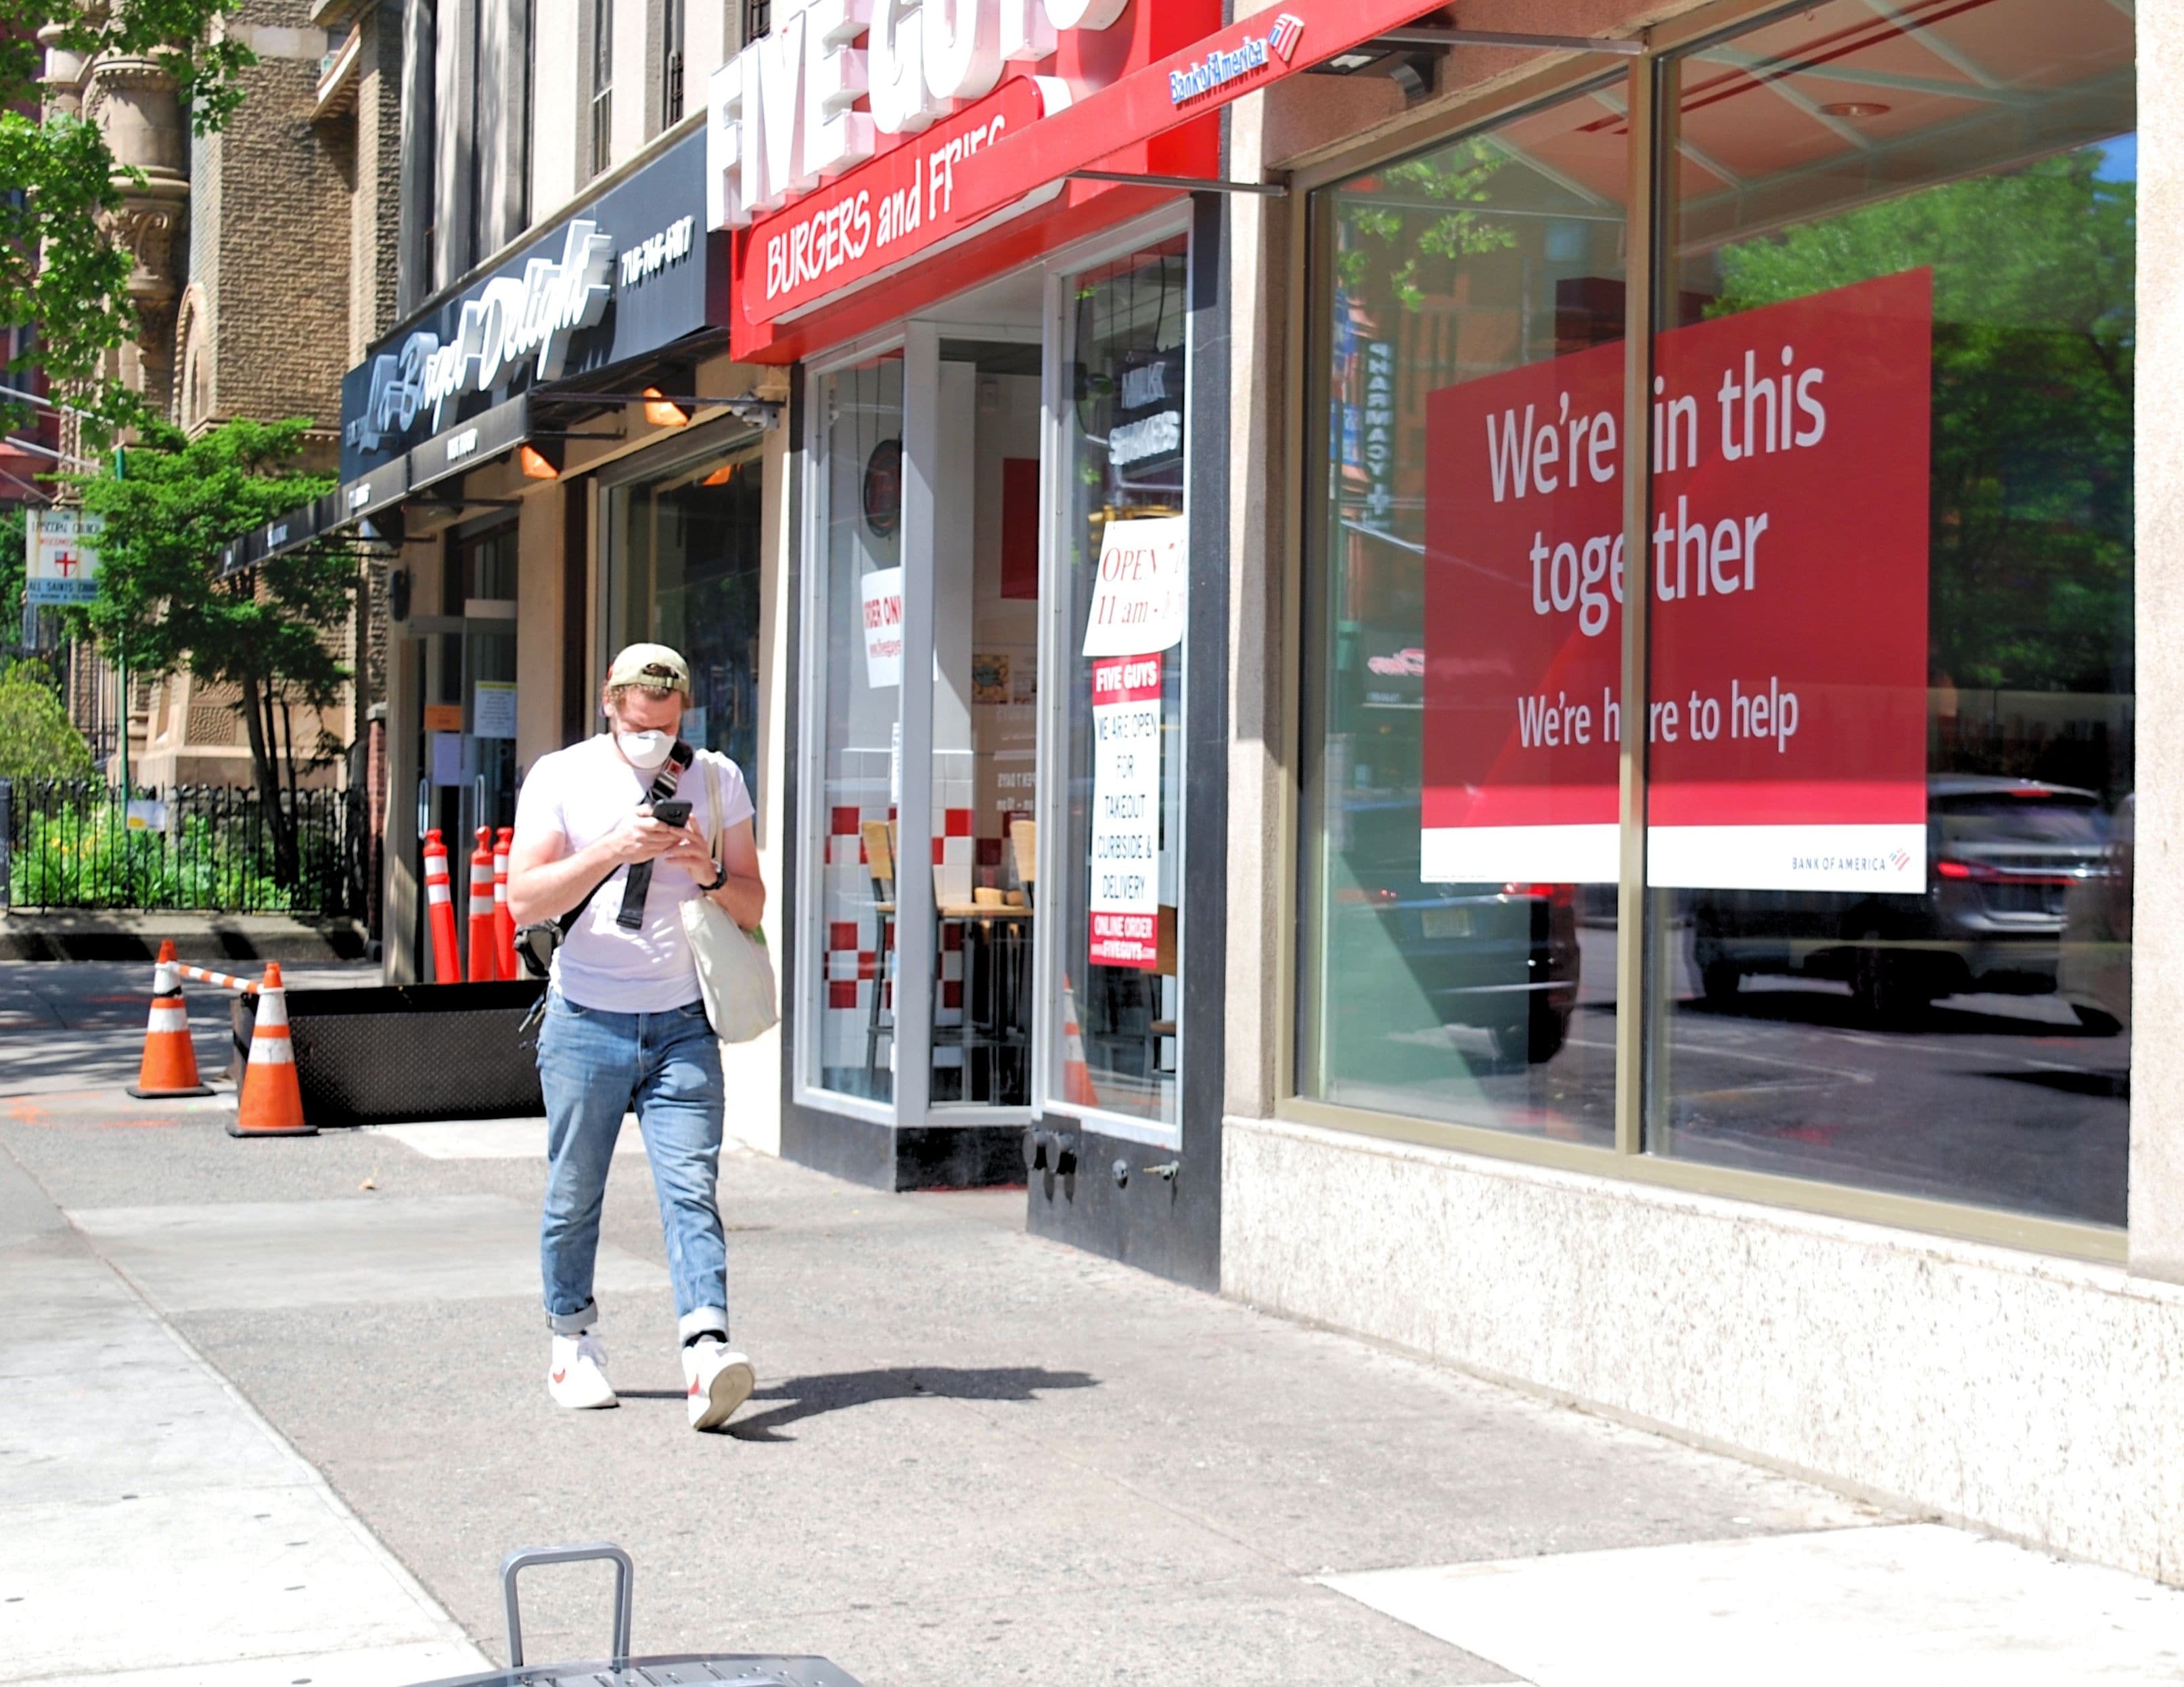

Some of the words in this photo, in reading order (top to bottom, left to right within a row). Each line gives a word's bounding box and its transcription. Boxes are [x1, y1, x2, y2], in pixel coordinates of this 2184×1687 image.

[1169, 63, 1201, 104] Bank
[1210, 37, 1269, 84] America
[706, 0, 857, 231] FIVE
[868, 0, 1113, 133] GU
[767, 189, 870, 300] BURGERS
[876, 158, 922, 247] and
[399, 300, 479, 434] Bagel
[476, 220, 598, 381] Delight
[1486, 391, 1617, 503] We're
[1654, 376, 1698, 474] in
[1717, 345, 1826, 462] this
[1097, 594, 1117, 625] 11
[1120, 601, 1149, 624] am
[1096, 665, 1122, 693] FIVE
[1123, 660, 1157, 690] GUYS
[1097, 717, 1108, 740] WE
[1112, 715, 1129, 738] ARE
[1131, 713, 1157, 738] OPEN
[1518, 691, 1591, 748] We're
[1604, 687, 1678, 743] hre
[1688, 690, 1720, 741] to
[1731, 676, 1799, 753] help
[1117, 755, 1134, 778] FOR
[1104, 793, 1145, 819] TAKEOUT
[1097, 834, 1143, 859] CURBSIDE
[1146, 834, 1152, 859] &
[1792, 857, 1819, 870] BANK
[1823, 857, 1836, 871] OF
[1838, 857, 1886, 872] AMERICA
[1103, 875, 1145, 900] DELIVERY
[1094, 914, 1124, 937] ONLINE
[1124, 916, 1153, 939] ORDER
